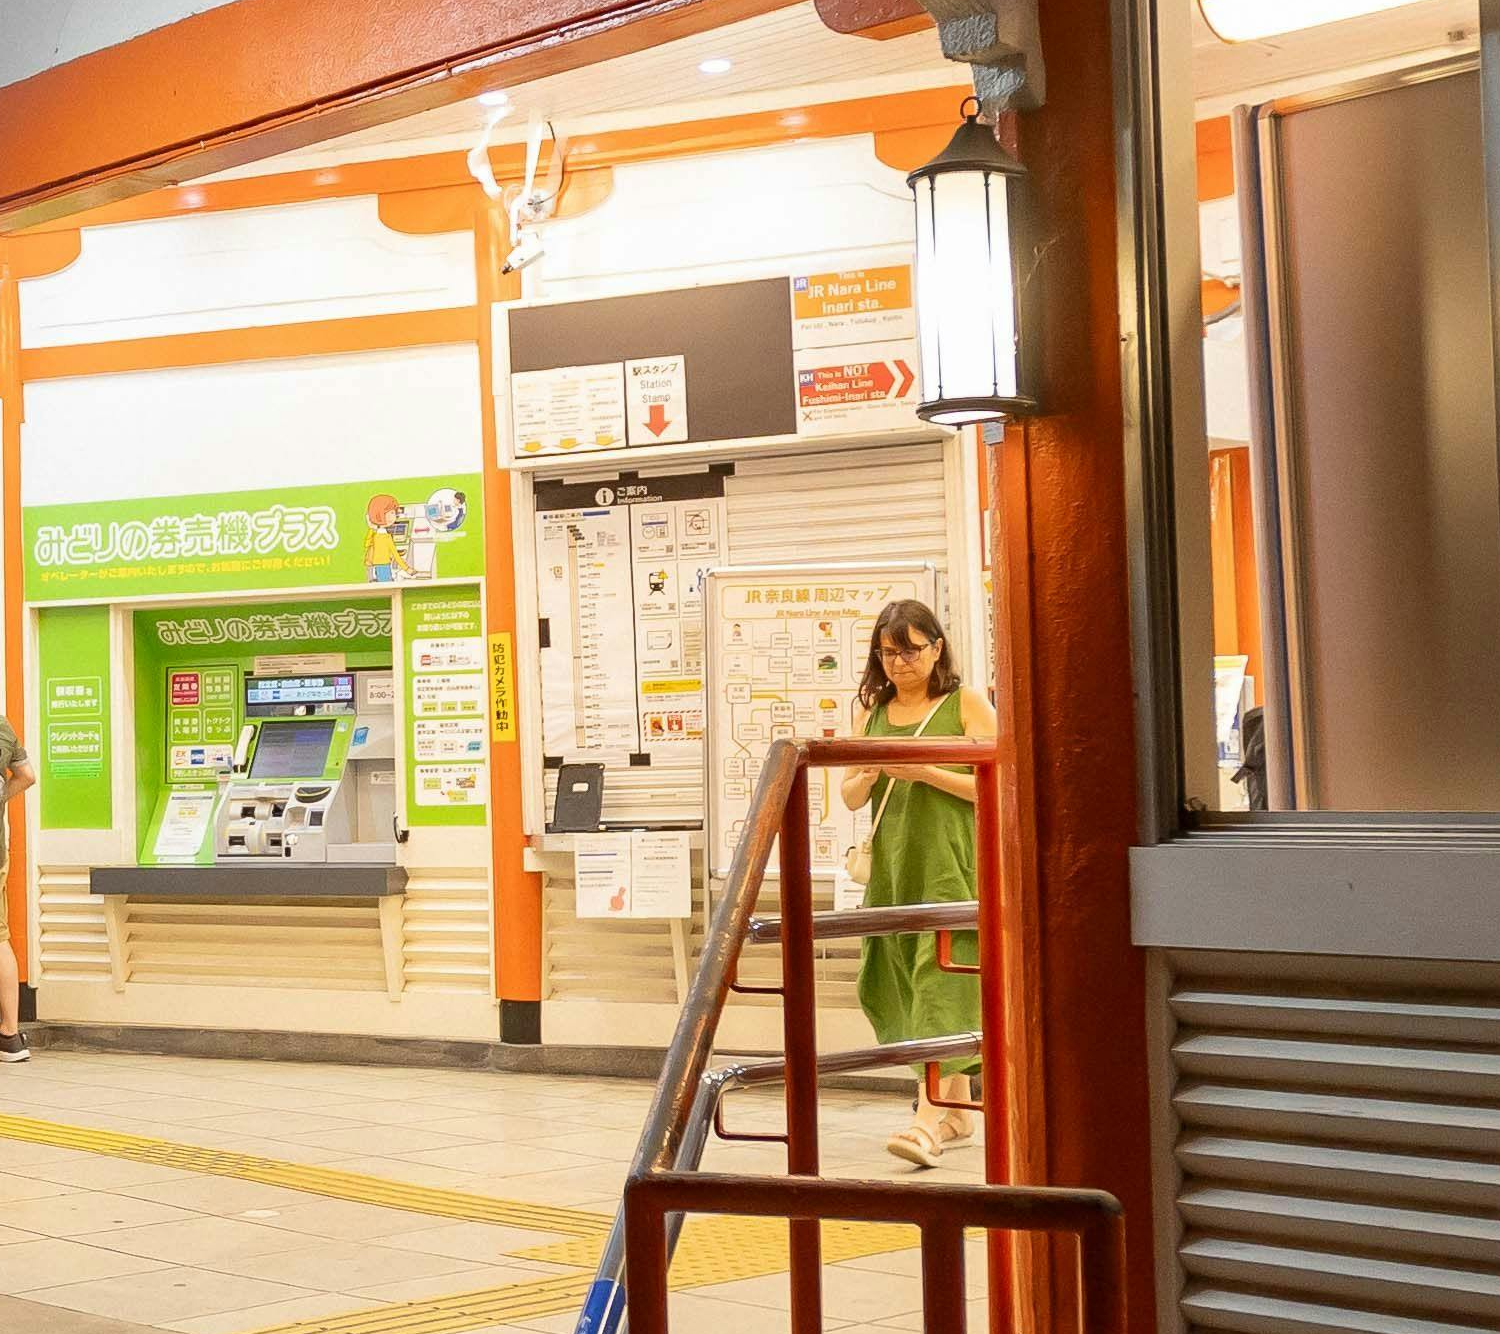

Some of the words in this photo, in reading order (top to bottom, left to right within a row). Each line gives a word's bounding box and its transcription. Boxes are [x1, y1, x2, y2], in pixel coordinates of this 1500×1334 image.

[795, 279, 807, 290] JR
[808, 286, 824, 299] JR
[828, 281, 861, 296] Nara
[866, 279, 896, 293] Line
[822, 299, 854, 314] Inari
[858, 297, 883, 310] sta.
[632, 362, 678, 376] 駅スタンプ
[844, 364, 869, 378] NOT
[640, 378, 672, 389] Station
[852, 378, 873, 388] Line
[642, 394, 670, 405] Stamp
[617, 485, 648, 496] ご案内
[617, 495, 662, 505] Information
[35, 505, 339, 566] みどりの券売機プラス
[745, 591, 762, 604] JR
[765, 589, 810, 603] 奈良線
[814, 585, 893, 603] 周辺マップ
[492, 643, 509, 732] 防犯カメラ作動中
